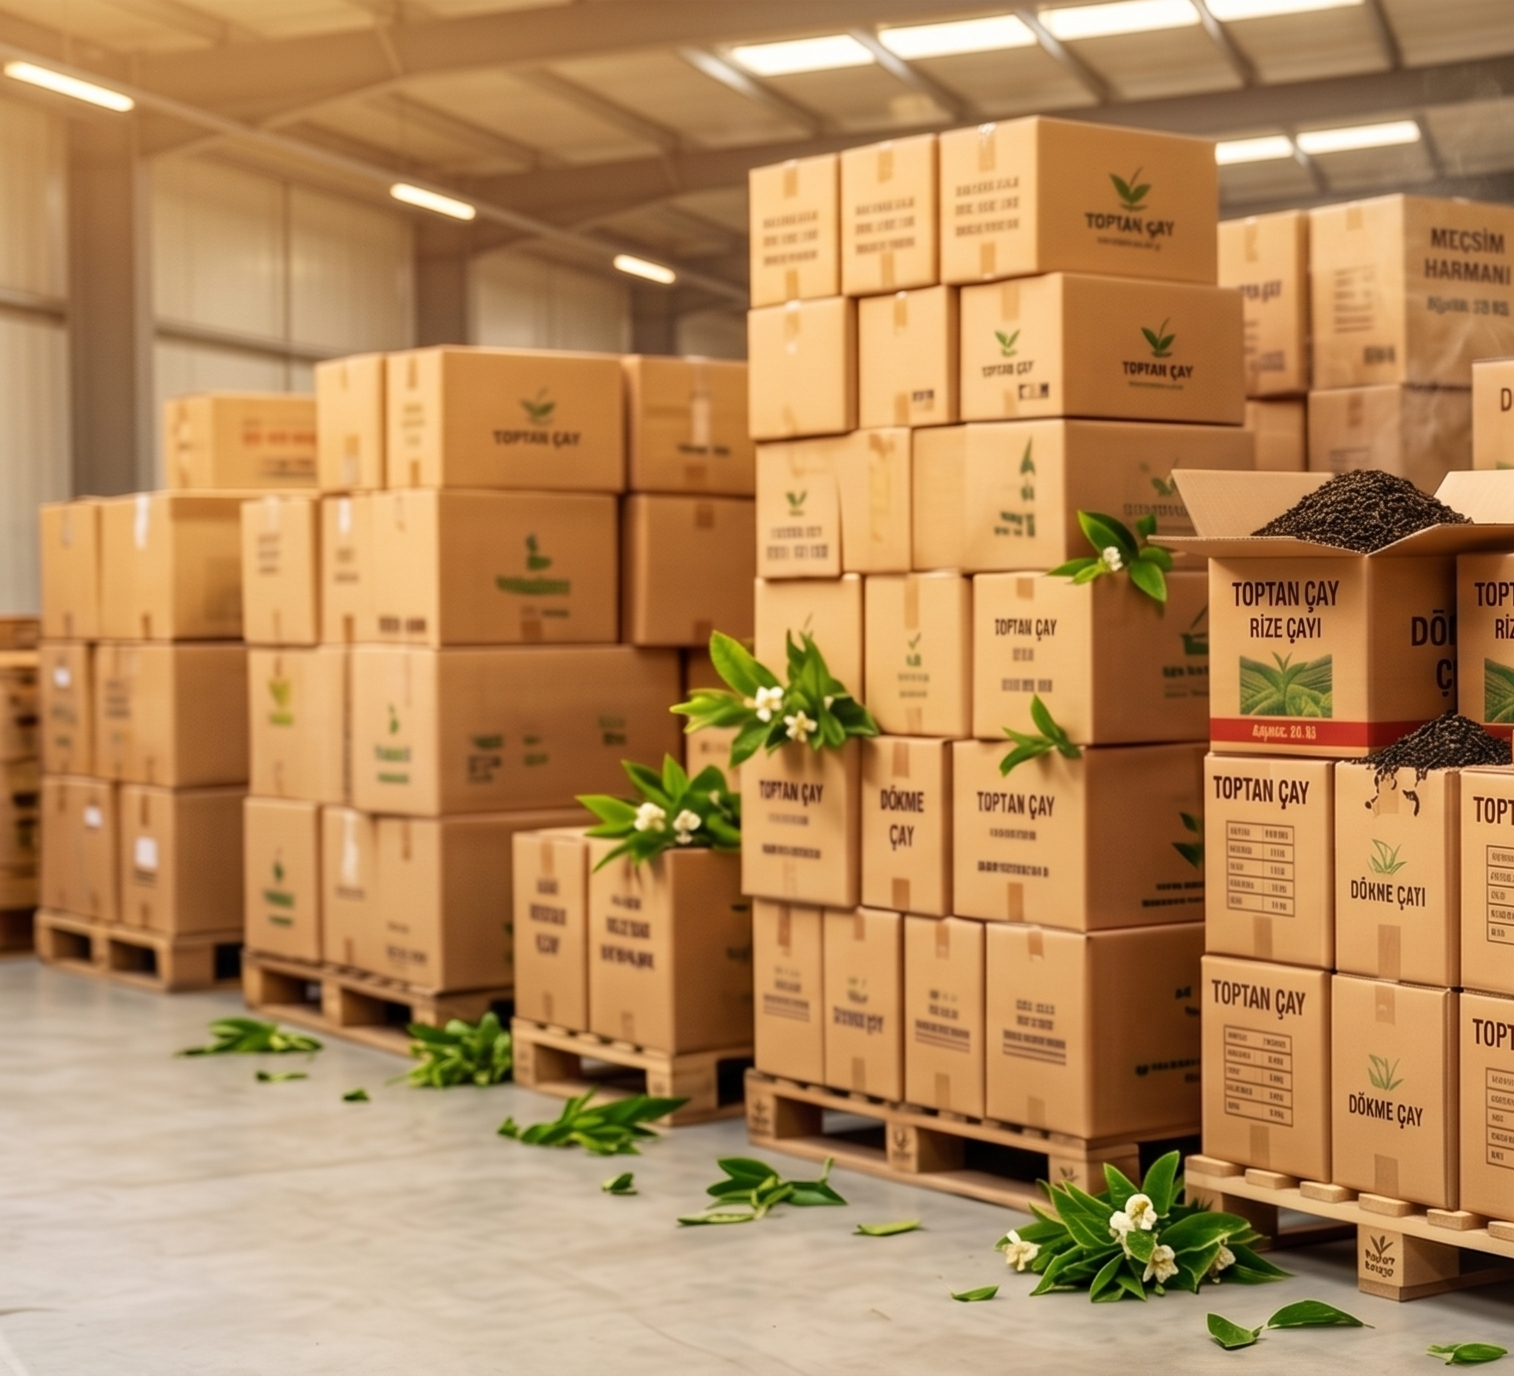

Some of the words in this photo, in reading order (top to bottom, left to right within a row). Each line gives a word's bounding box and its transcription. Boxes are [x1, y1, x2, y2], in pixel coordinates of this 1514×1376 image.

[1085, 212, 1143, 234] TOPTAN
[1424, 259, 1511, 287] HARMANI
[1231, 581, 1300, 608] TOPTAN
[1304, 580, 1340, 615] ÇAY
[1035, 619, 1058, 642] ÇAY
[1250, 613, 1282, 639] RİZE
[1286, 617, 1322, 645] ÇAYI
[800, 783, 824, 806] ÇAY
[976, 790, 1026, 815] TOPTAN
[1028, 794, 1056, 820] ÇAY
[1213, 775, 1274, 803] TOPTAN
[1278, 779, 1310, 810] ÇAY
[889, 825, 914, 851] ÇAY
[1211, 979, 1271, 1011] TOPTAN
[1275, 989, 1306, 1021] ÇAY
[1397, 1104, 1424, 1129] ÇAY
